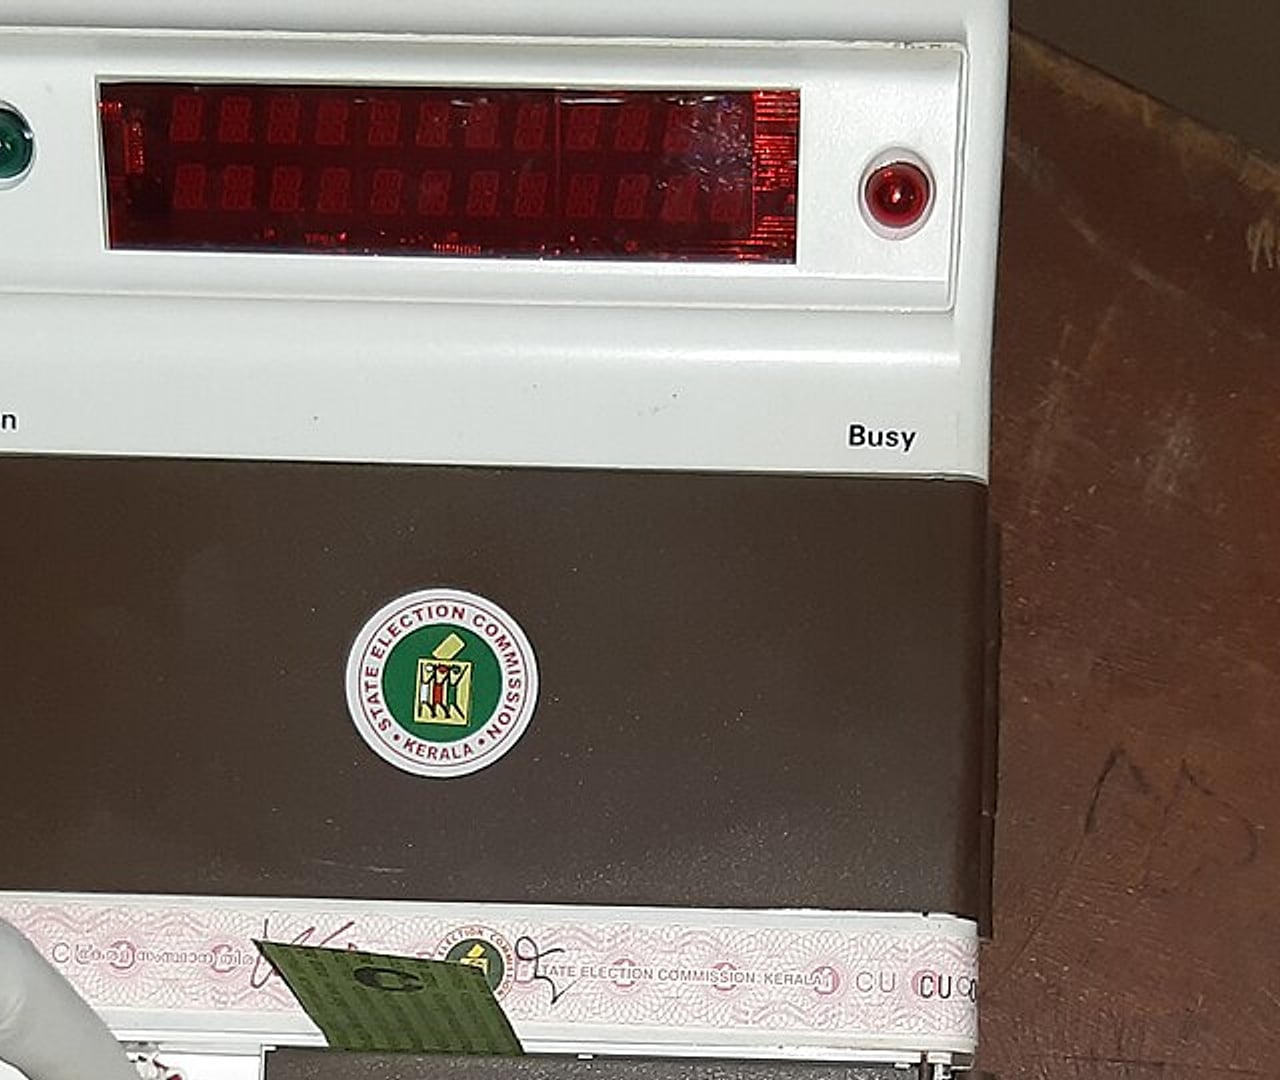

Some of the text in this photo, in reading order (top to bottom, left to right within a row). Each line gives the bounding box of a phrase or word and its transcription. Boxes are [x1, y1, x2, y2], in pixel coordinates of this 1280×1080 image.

[849, 424, 917, 453] Busy
[365, 605, 521, 740] STATE ELECTION COMMISSION
[403, 737, 474, 760] KERALA
[580, 966, 653, 980] ELECTION
[763, 973, 822, 985] KERALA
